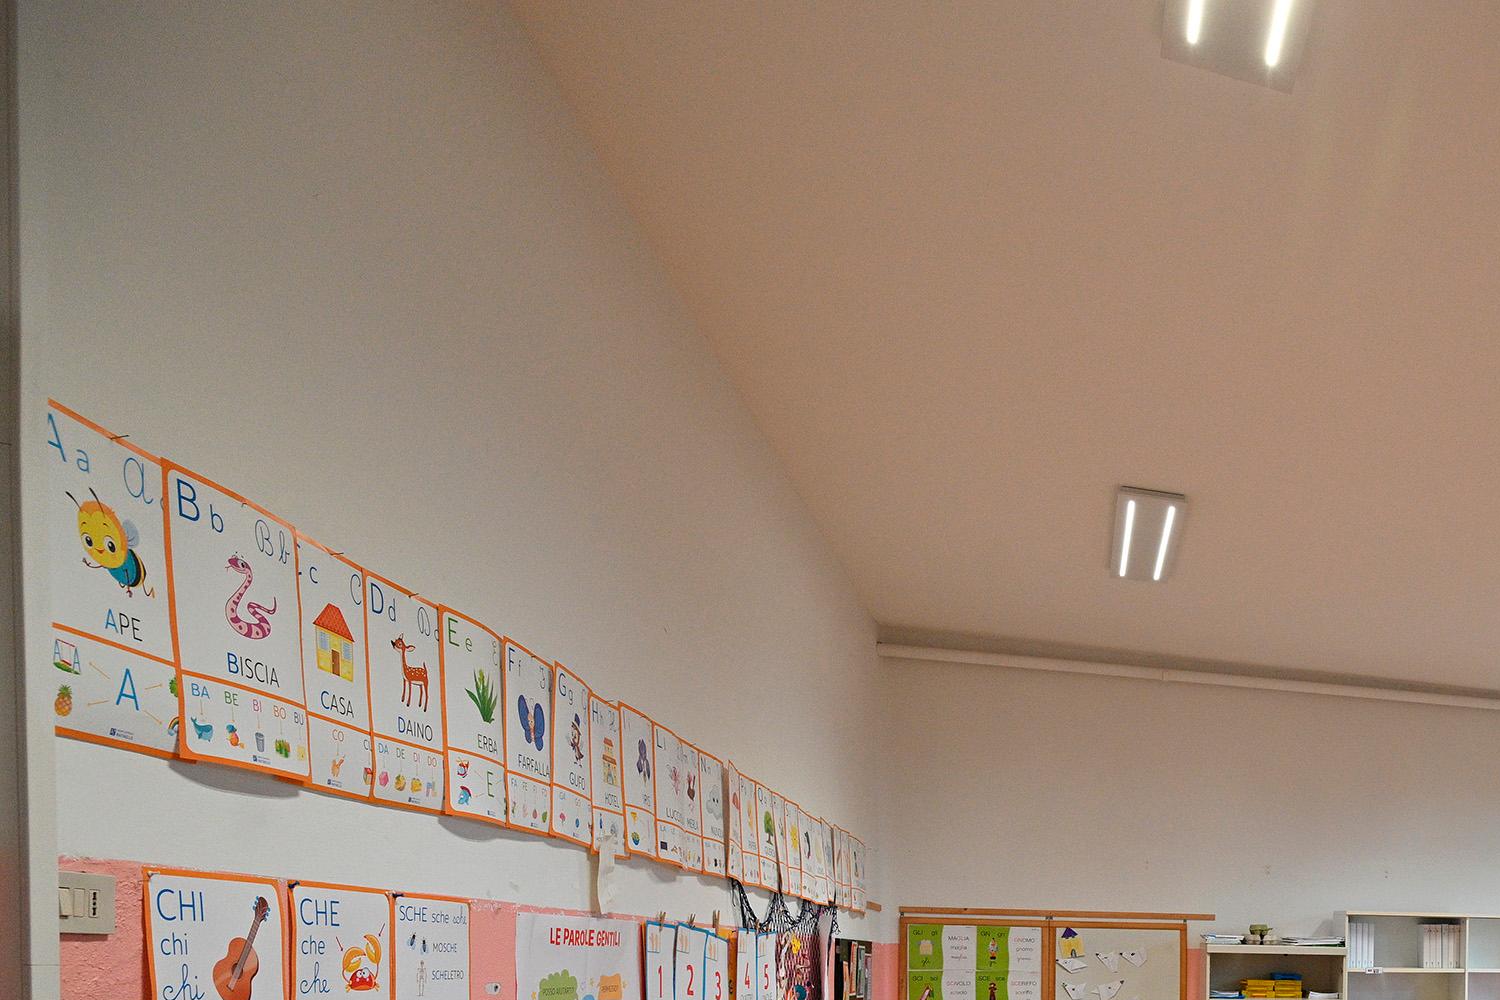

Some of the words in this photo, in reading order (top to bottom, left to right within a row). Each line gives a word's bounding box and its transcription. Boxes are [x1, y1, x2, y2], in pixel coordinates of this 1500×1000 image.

[77, 449, 90, 473] a
[177, 478, 200, 522] B
[209, 503, 224, 533] b
[371, 582, 384, 614] D
[388, 598, 396, 622] d
[105, 608, 143, 642] APE
[448, 617, 460, 647] E
[465, 637, 473, 652] e
[227, 651, 280, 688] BISCIA
[508, 646, 515, 671] F
[116, 667, 140, 711] A
[558, 672, 567, 697] G
[191, 682, 210, 700] BA
[224, 690, 239, 707] BE
[252, 698, 262, 713] BI
[273, 705, 286, 720] BO
[320, 690, 355, 718] CASA
[332, 729, 344, 742] CO
[398, 716, 433, 742] DAINO
[378, 742, 389, 754] DA
[396, 747, 405, 759] DE
[477, 733, 498, 755] ERBA
[518, 753, 550, 777] FARFALLA
[487, 771, 494, 798] E
[156, 888, 205, 922] CHI
[299, 898, 340, 927] CHE
[399, 905, 428, 923] SCHE
[431, 911, 450, 924] sche
[160, 932, 188, 956] chi
[301, 935, 326, 955] che
[432, 942, 457, 953] MOSCHE
[549, 927, 561, 946] LE
[563, 927, 595, 947] PAROLE
[596, 930, 621, 948] GENTILI
[299, 961, 330, 994] che
[431, 969, 464, 981] SCHELETRO
[657, 965, 663, 998] 1
[686, 964, 694, 996] 2
[715, 971, 722, 1000] 3
[744, 962, 750, 989] 4
[764, 963, 769, 990] 5
